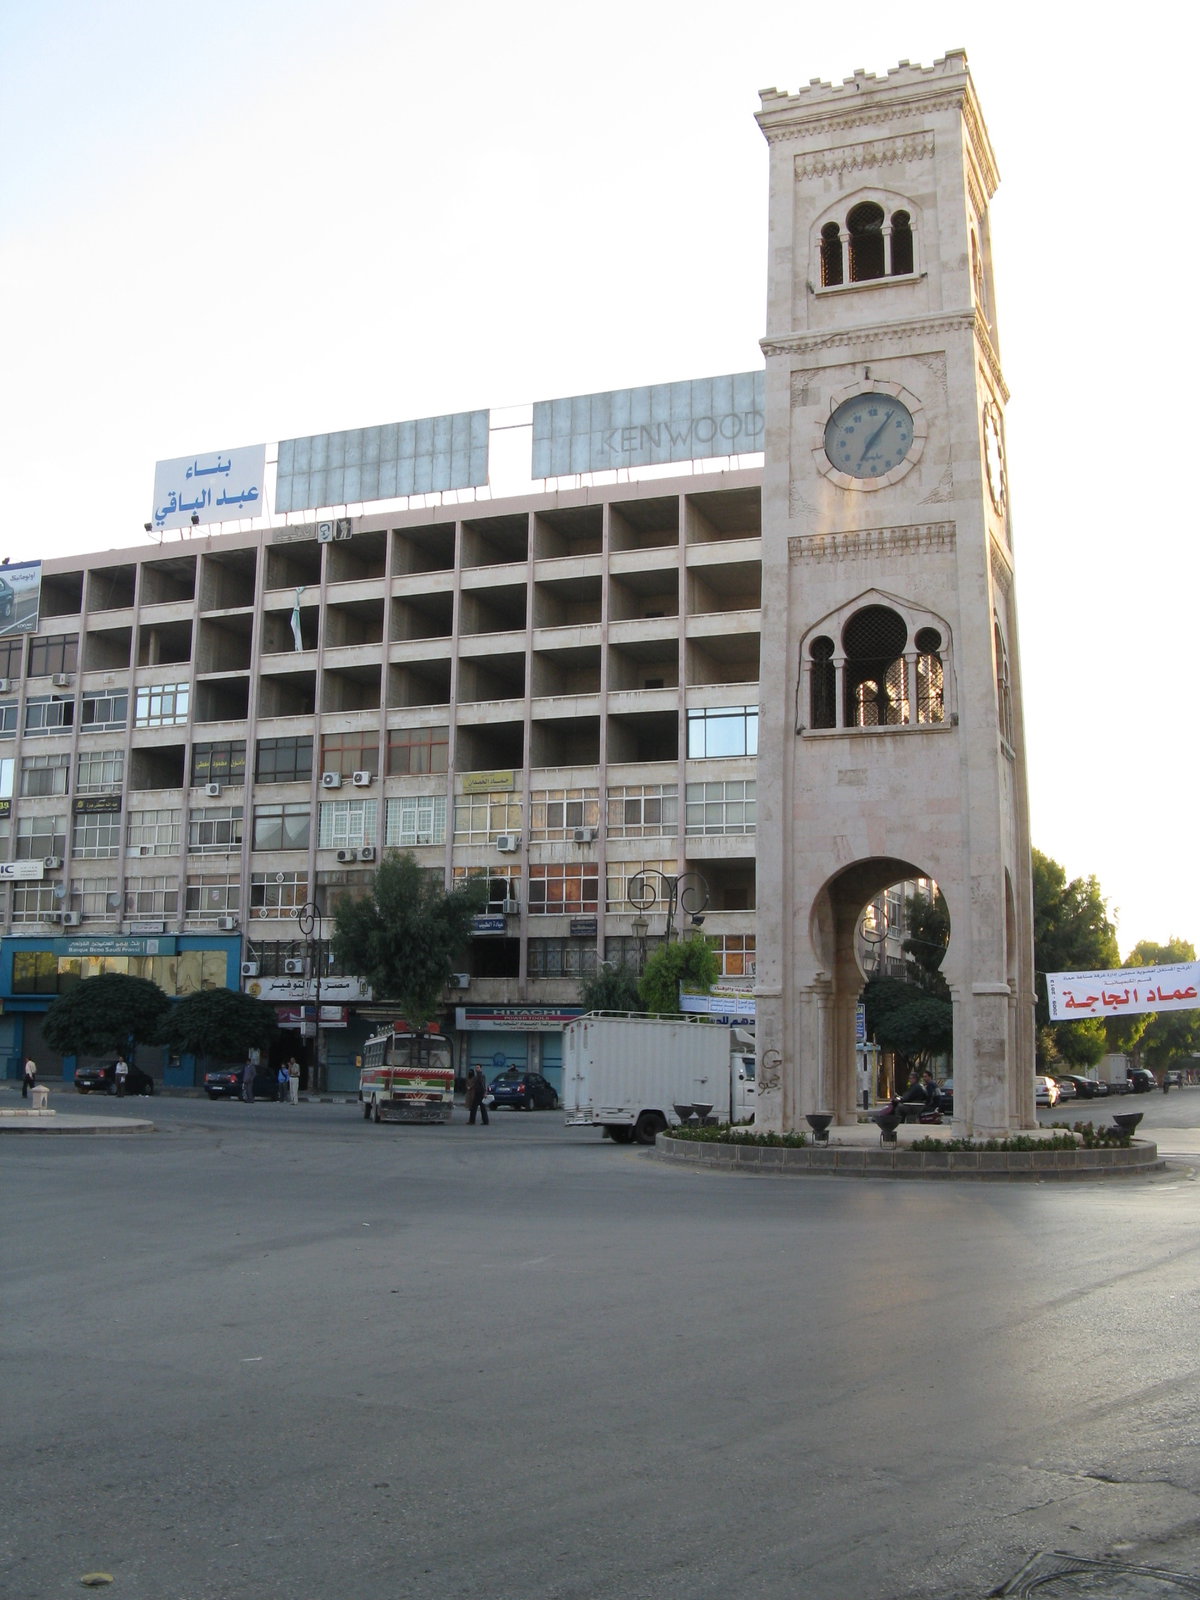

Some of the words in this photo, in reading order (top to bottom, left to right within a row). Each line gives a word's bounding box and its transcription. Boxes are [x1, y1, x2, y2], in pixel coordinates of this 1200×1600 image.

[868, 408, 878, 416] 12
[853, 415, 862, 423] 11
[895, 420, 903, 428] 2
[599, 410, 764, 455] KENWOOD
[844, 426, 855, 434] 10
[900, 433, 907, 441] 3
[855, 463, 863, 471] 7
[216, 486, 259, 509] عبد
[155, 487, 211, 526] الباقي
[269, 979, 309, 991] التوفير
[1146, 985, 1198, 1003] عماد
[1062, 988, 1139, 1013] الجاجة
